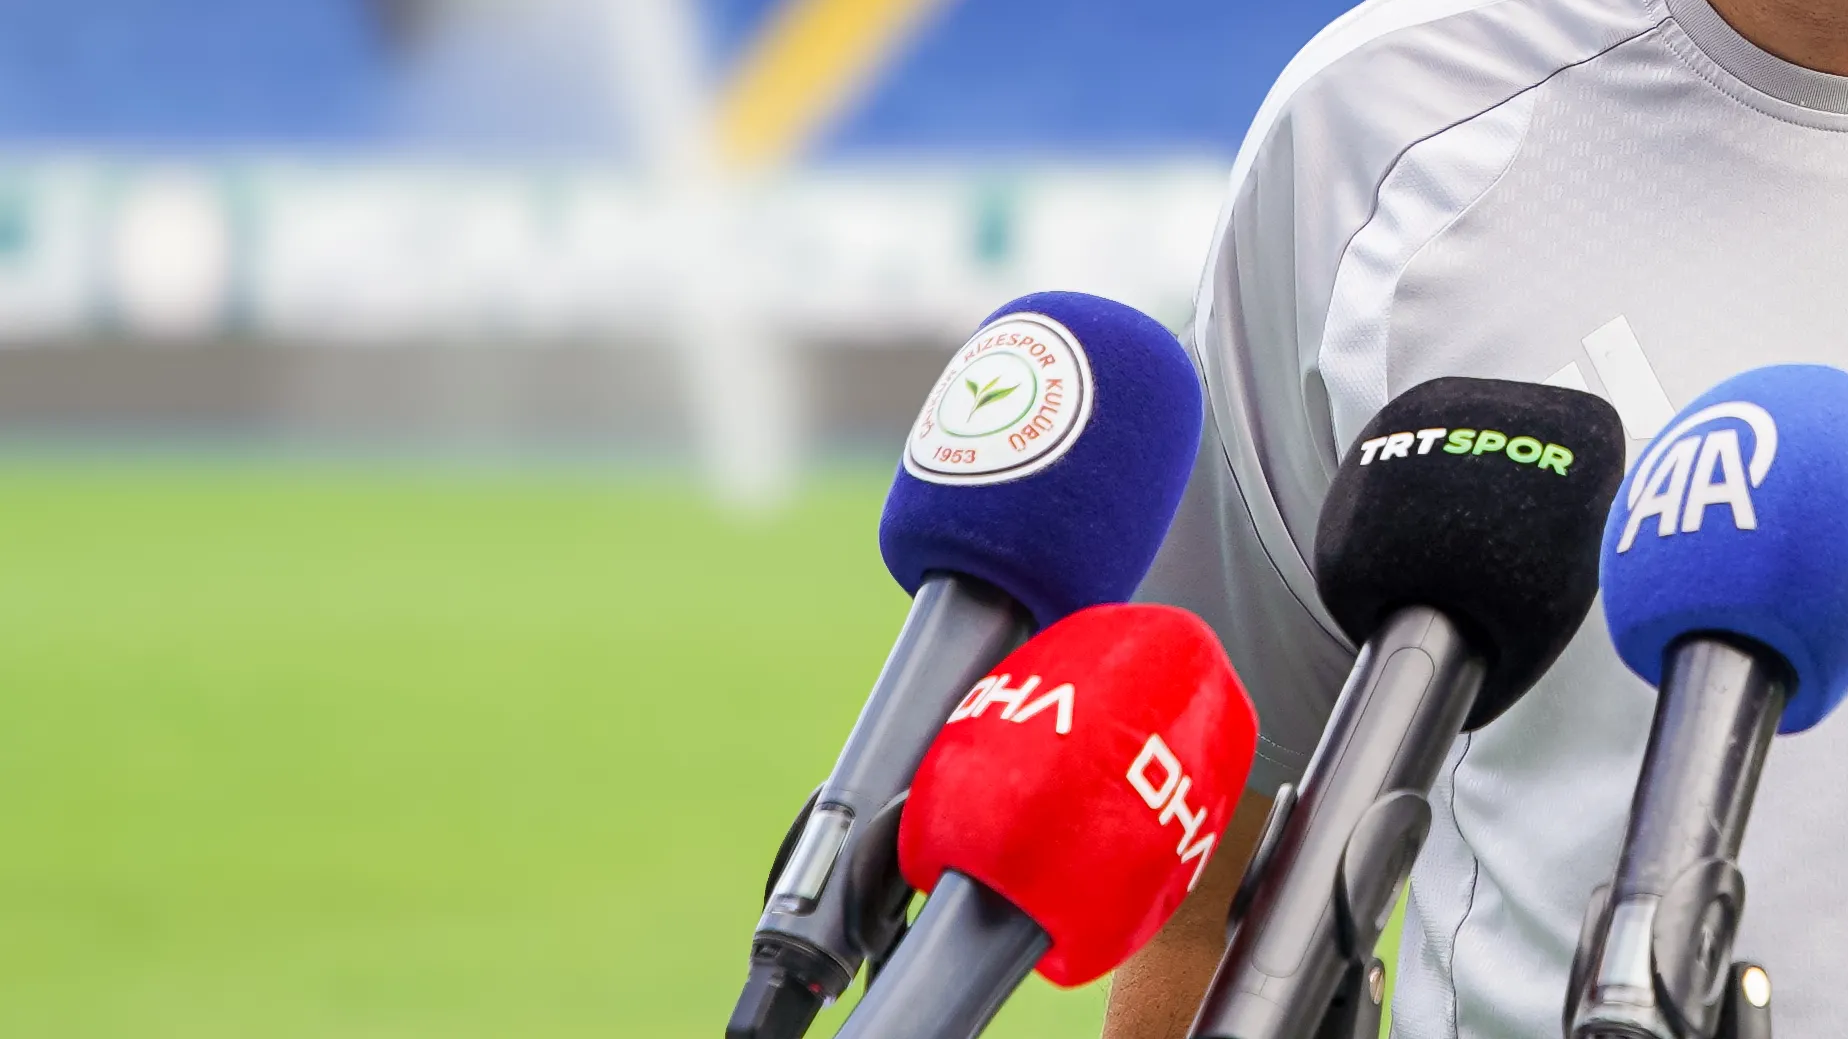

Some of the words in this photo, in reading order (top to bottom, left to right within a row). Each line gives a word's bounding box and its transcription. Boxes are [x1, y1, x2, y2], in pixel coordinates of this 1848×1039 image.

[1008, 378, 1063, 452] KULÜBÜ
[932, 445, 977, 464] 1953
[1616, 429, 1758, 555] AA
[945, 673, 1076, 735] DHA
[1125, 732, 1218, 893] DHA
